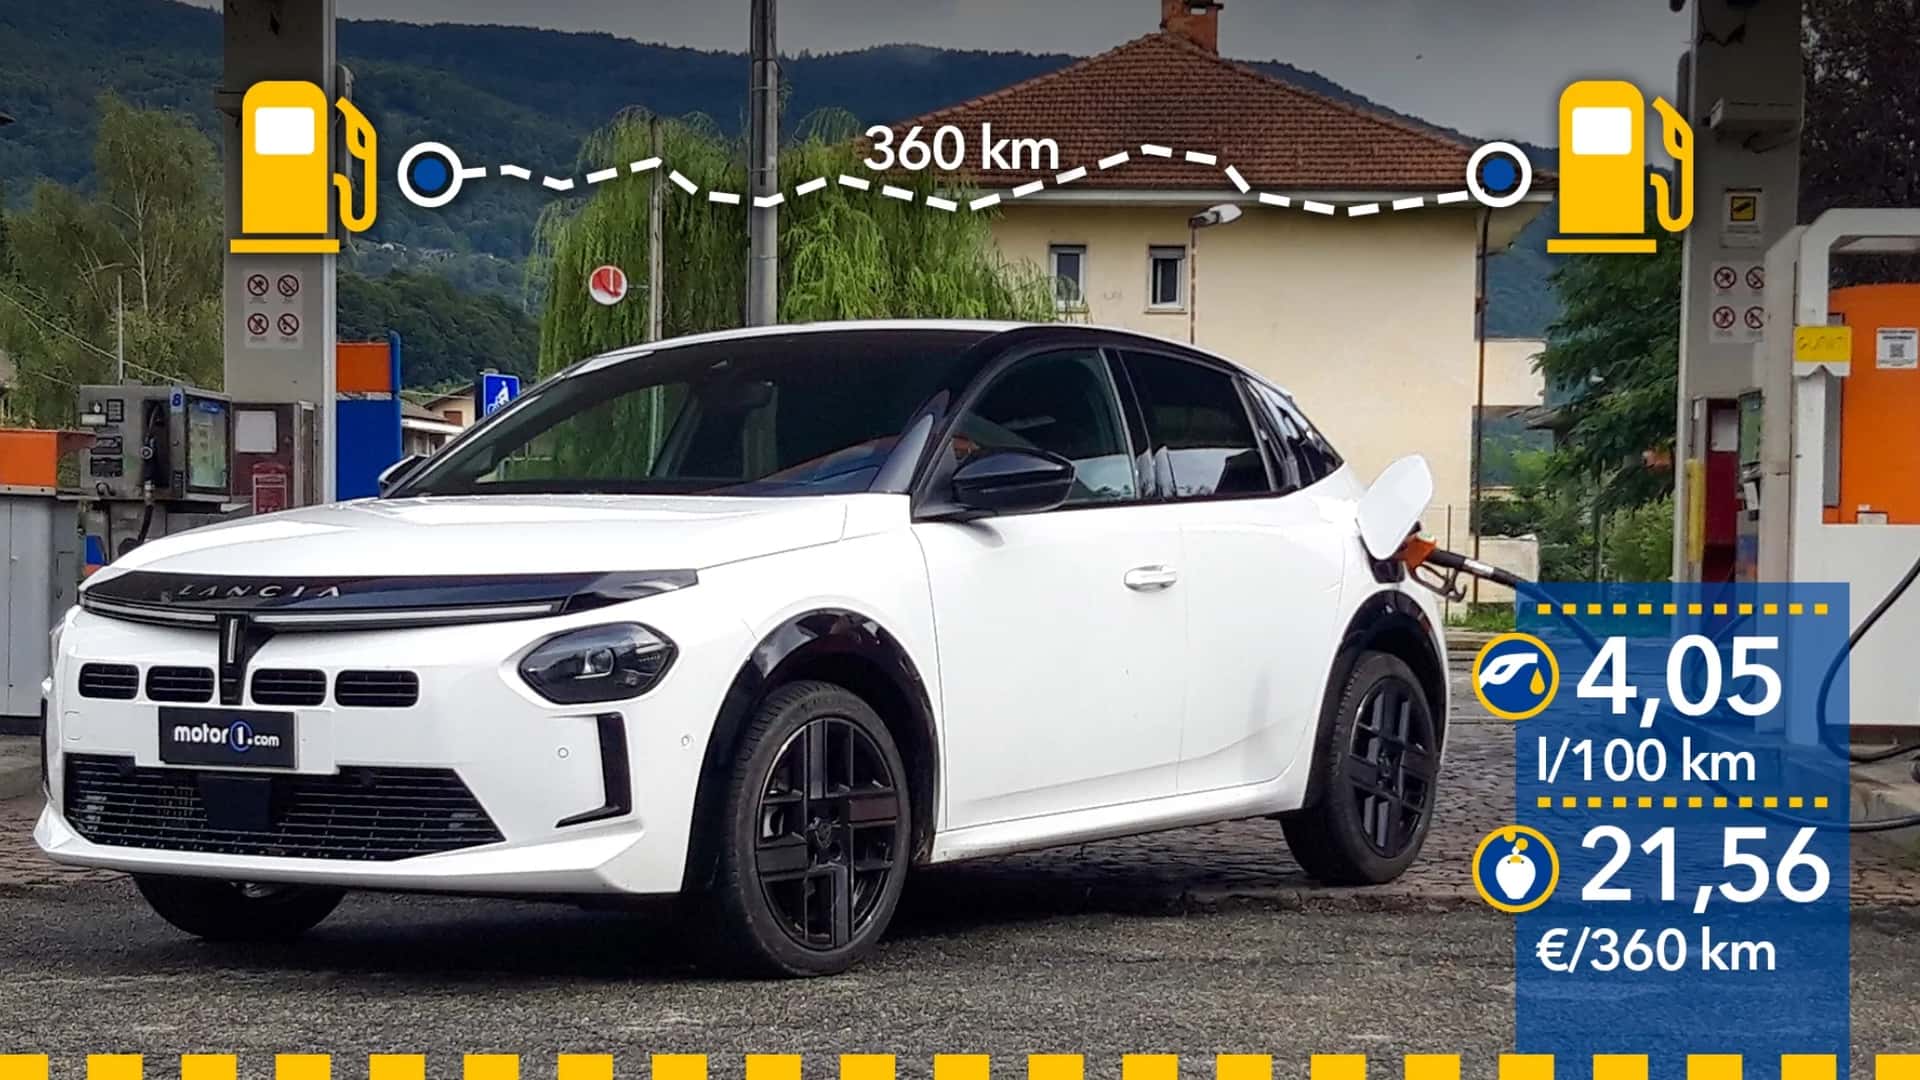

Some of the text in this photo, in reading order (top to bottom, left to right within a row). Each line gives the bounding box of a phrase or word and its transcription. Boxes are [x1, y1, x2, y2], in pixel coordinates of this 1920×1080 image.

[172, 393, 182, 407] 8
[178, 584, 340, 598] LANCIA
[174, 721, 280, 750] motor1.com
